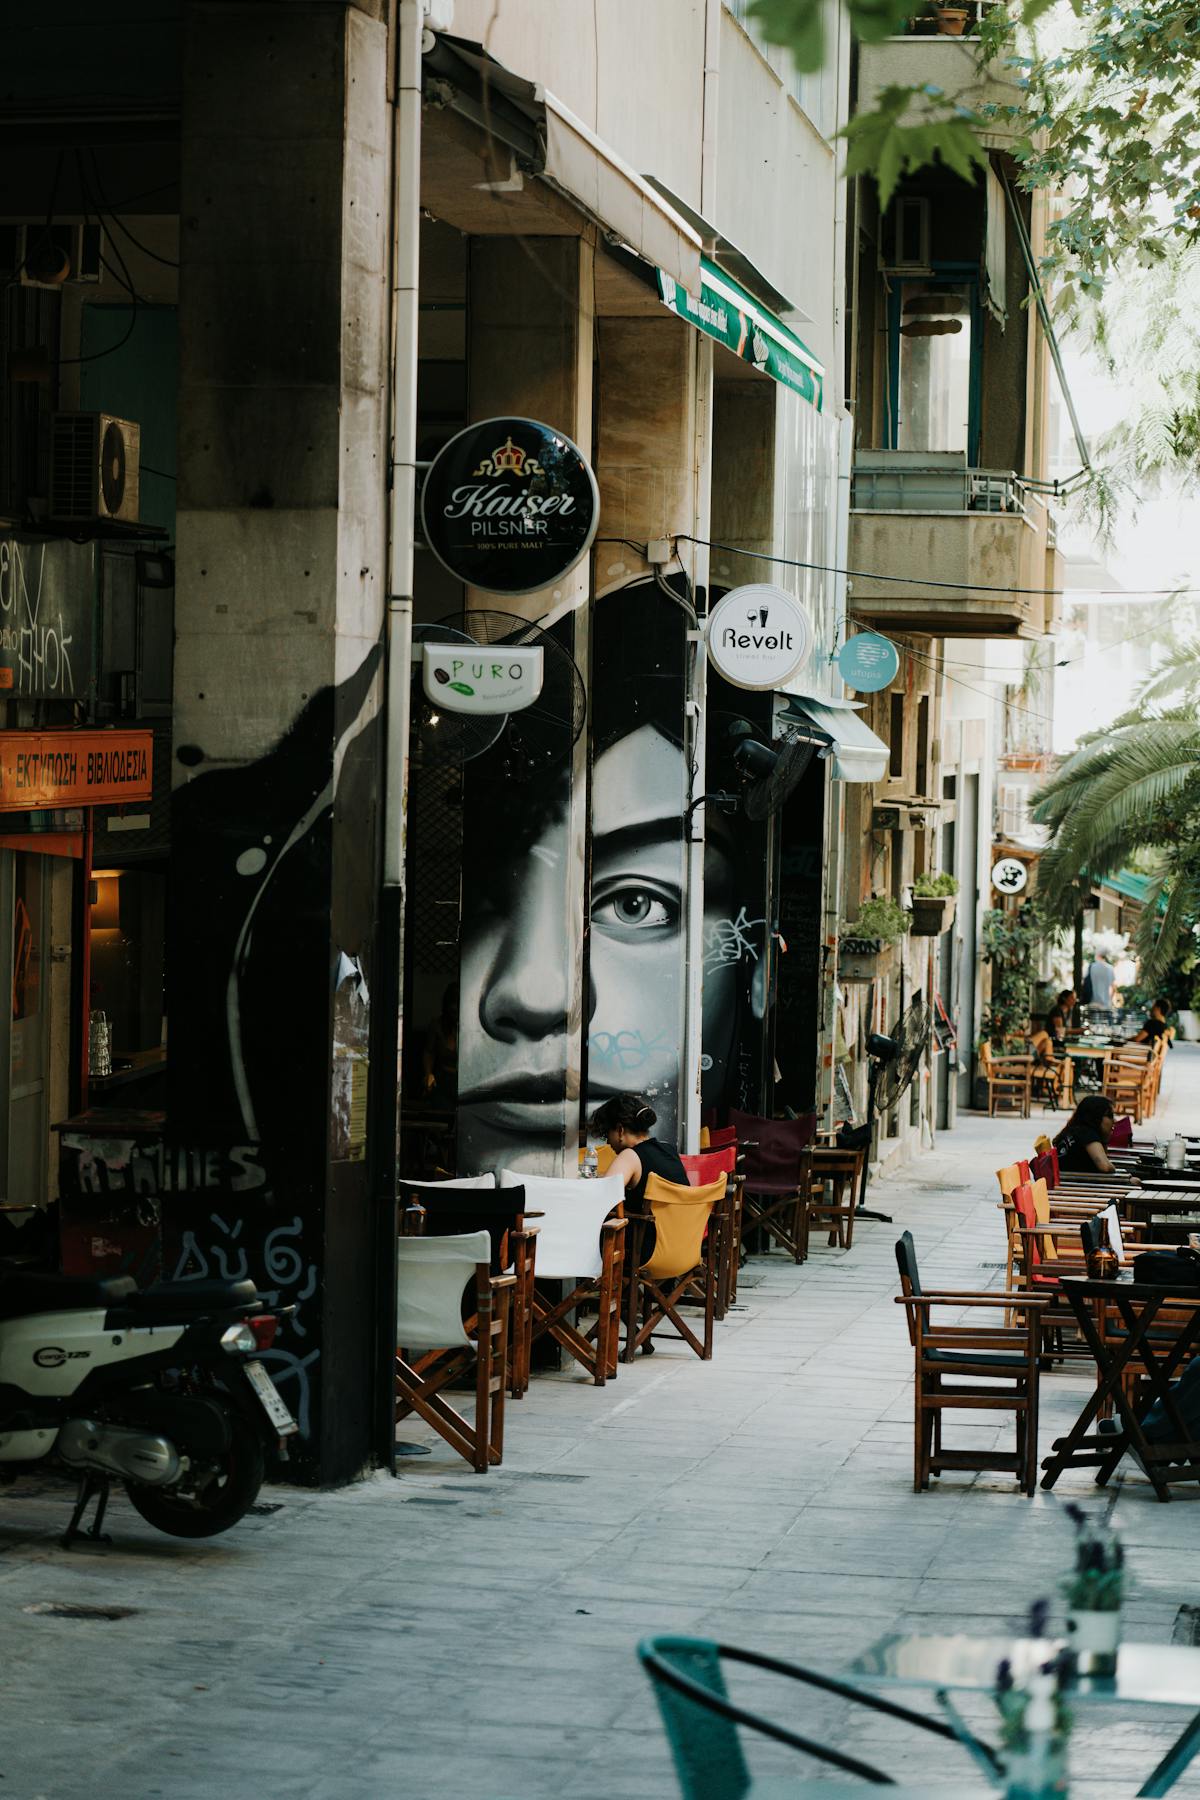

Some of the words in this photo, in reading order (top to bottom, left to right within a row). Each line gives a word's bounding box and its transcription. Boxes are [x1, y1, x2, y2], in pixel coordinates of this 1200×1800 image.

[443, 483, 576, 519] Kaiser
[471, 520, 548, 536] PILSNER
[520, 541, 544, 550] MALT
[722, 628, 793, 651] Revolt
[452, 660, 523, 680] PURO
[16, 752, 77, 788] ΕΚΤΥΠΩΣΗ
[87, 749, 147, 785] ΒΙΒΛΙΟΔΕΣΙΑ
